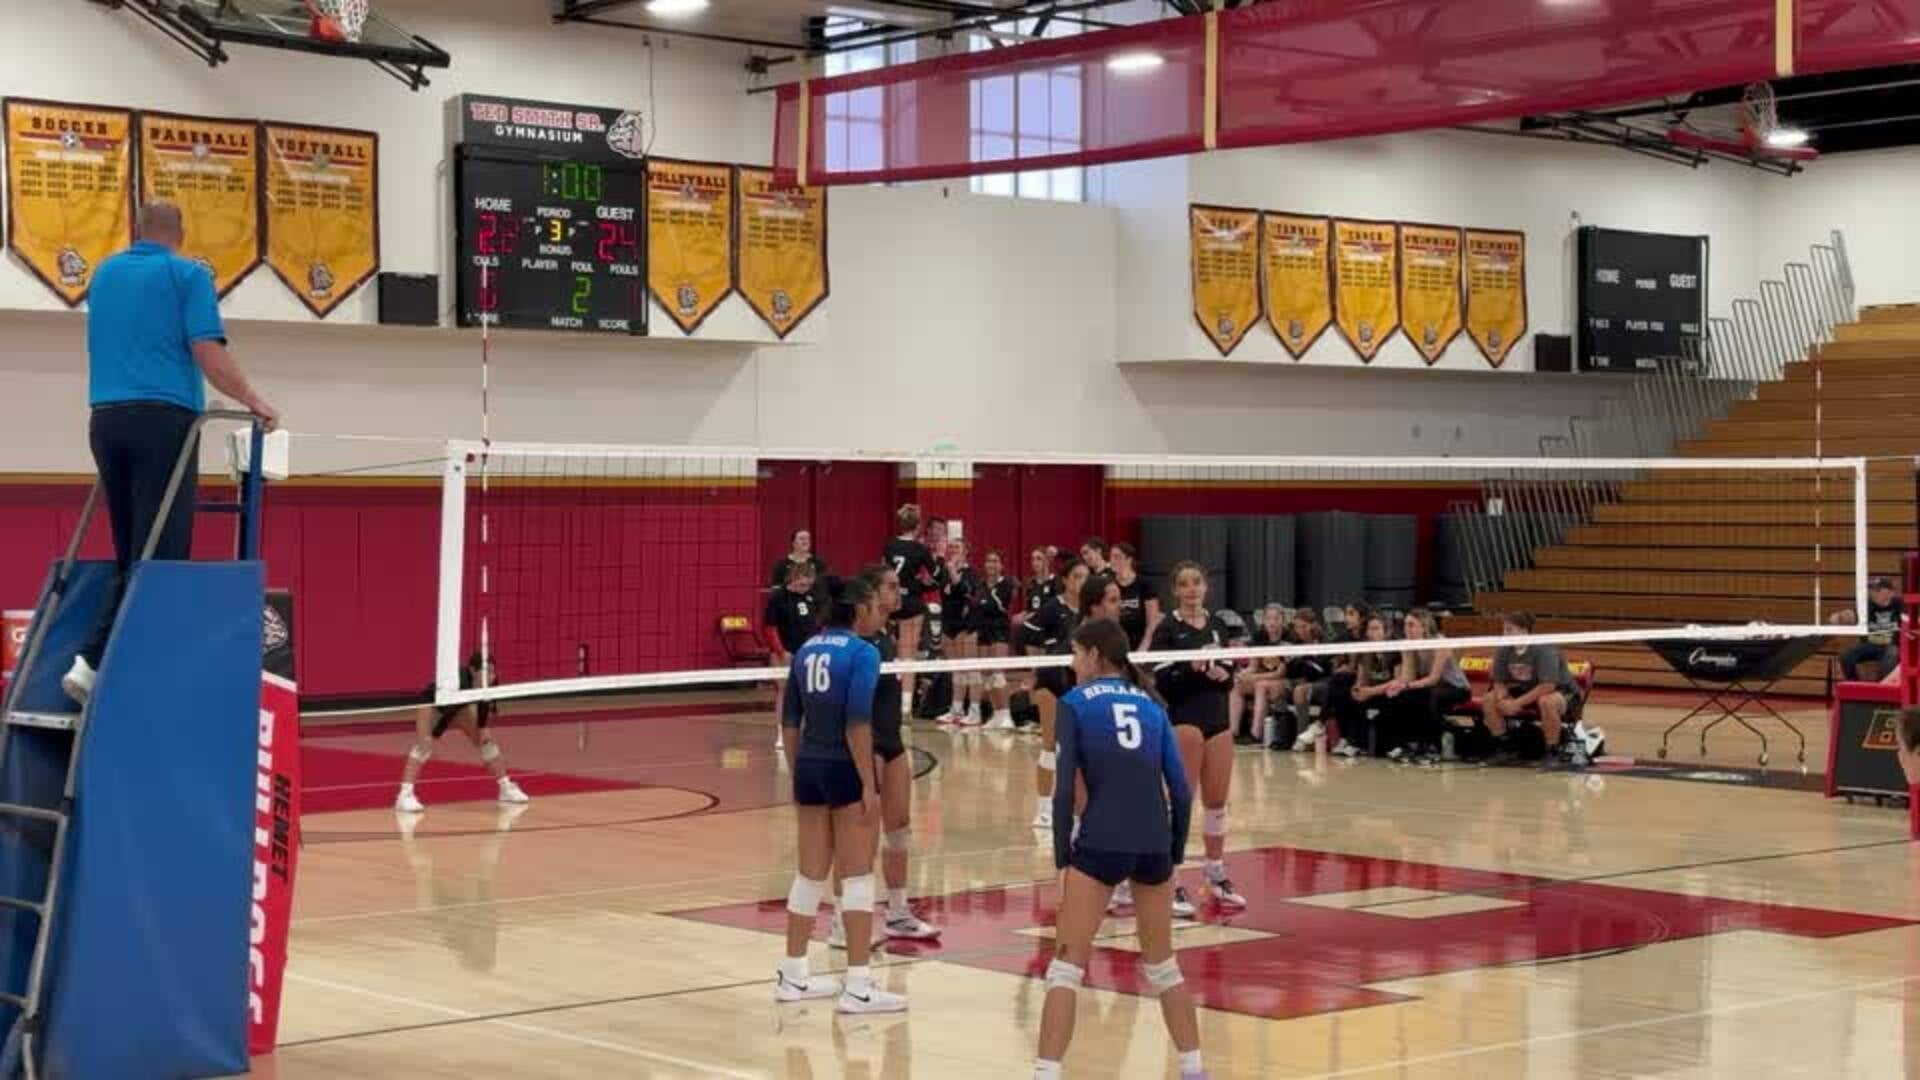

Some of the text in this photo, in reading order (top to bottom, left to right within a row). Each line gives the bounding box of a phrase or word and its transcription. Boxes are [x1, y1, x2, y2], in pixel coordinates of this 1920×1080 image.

[32, 117, 107, 134] SOCCER
[470, 102, 605, 132] TED SMITH SR.
[150, 128, 248, 147] BASEBALL
[495, 125, 583, 143] GYMNASIUM
[276, 138, 366, 159] SOFTBALL
[475, 197, 512, 212] HOME
[596, 206, 635, 220] GUEST
[549, 220, 562, 242] 3
[521, 258, 595, 273] PLAYER FOUL
[609, 264, 639, 275] FOULS
[573, 275, 592, 313] 2
[551, 316, 631, 331] MATCH SCORE
[893, 555, 906, 575] 7
[804, 652, 831, 693] 16
[1112, 702, 1142, 750] 5
[271, 772, 291, 884] HEMET
